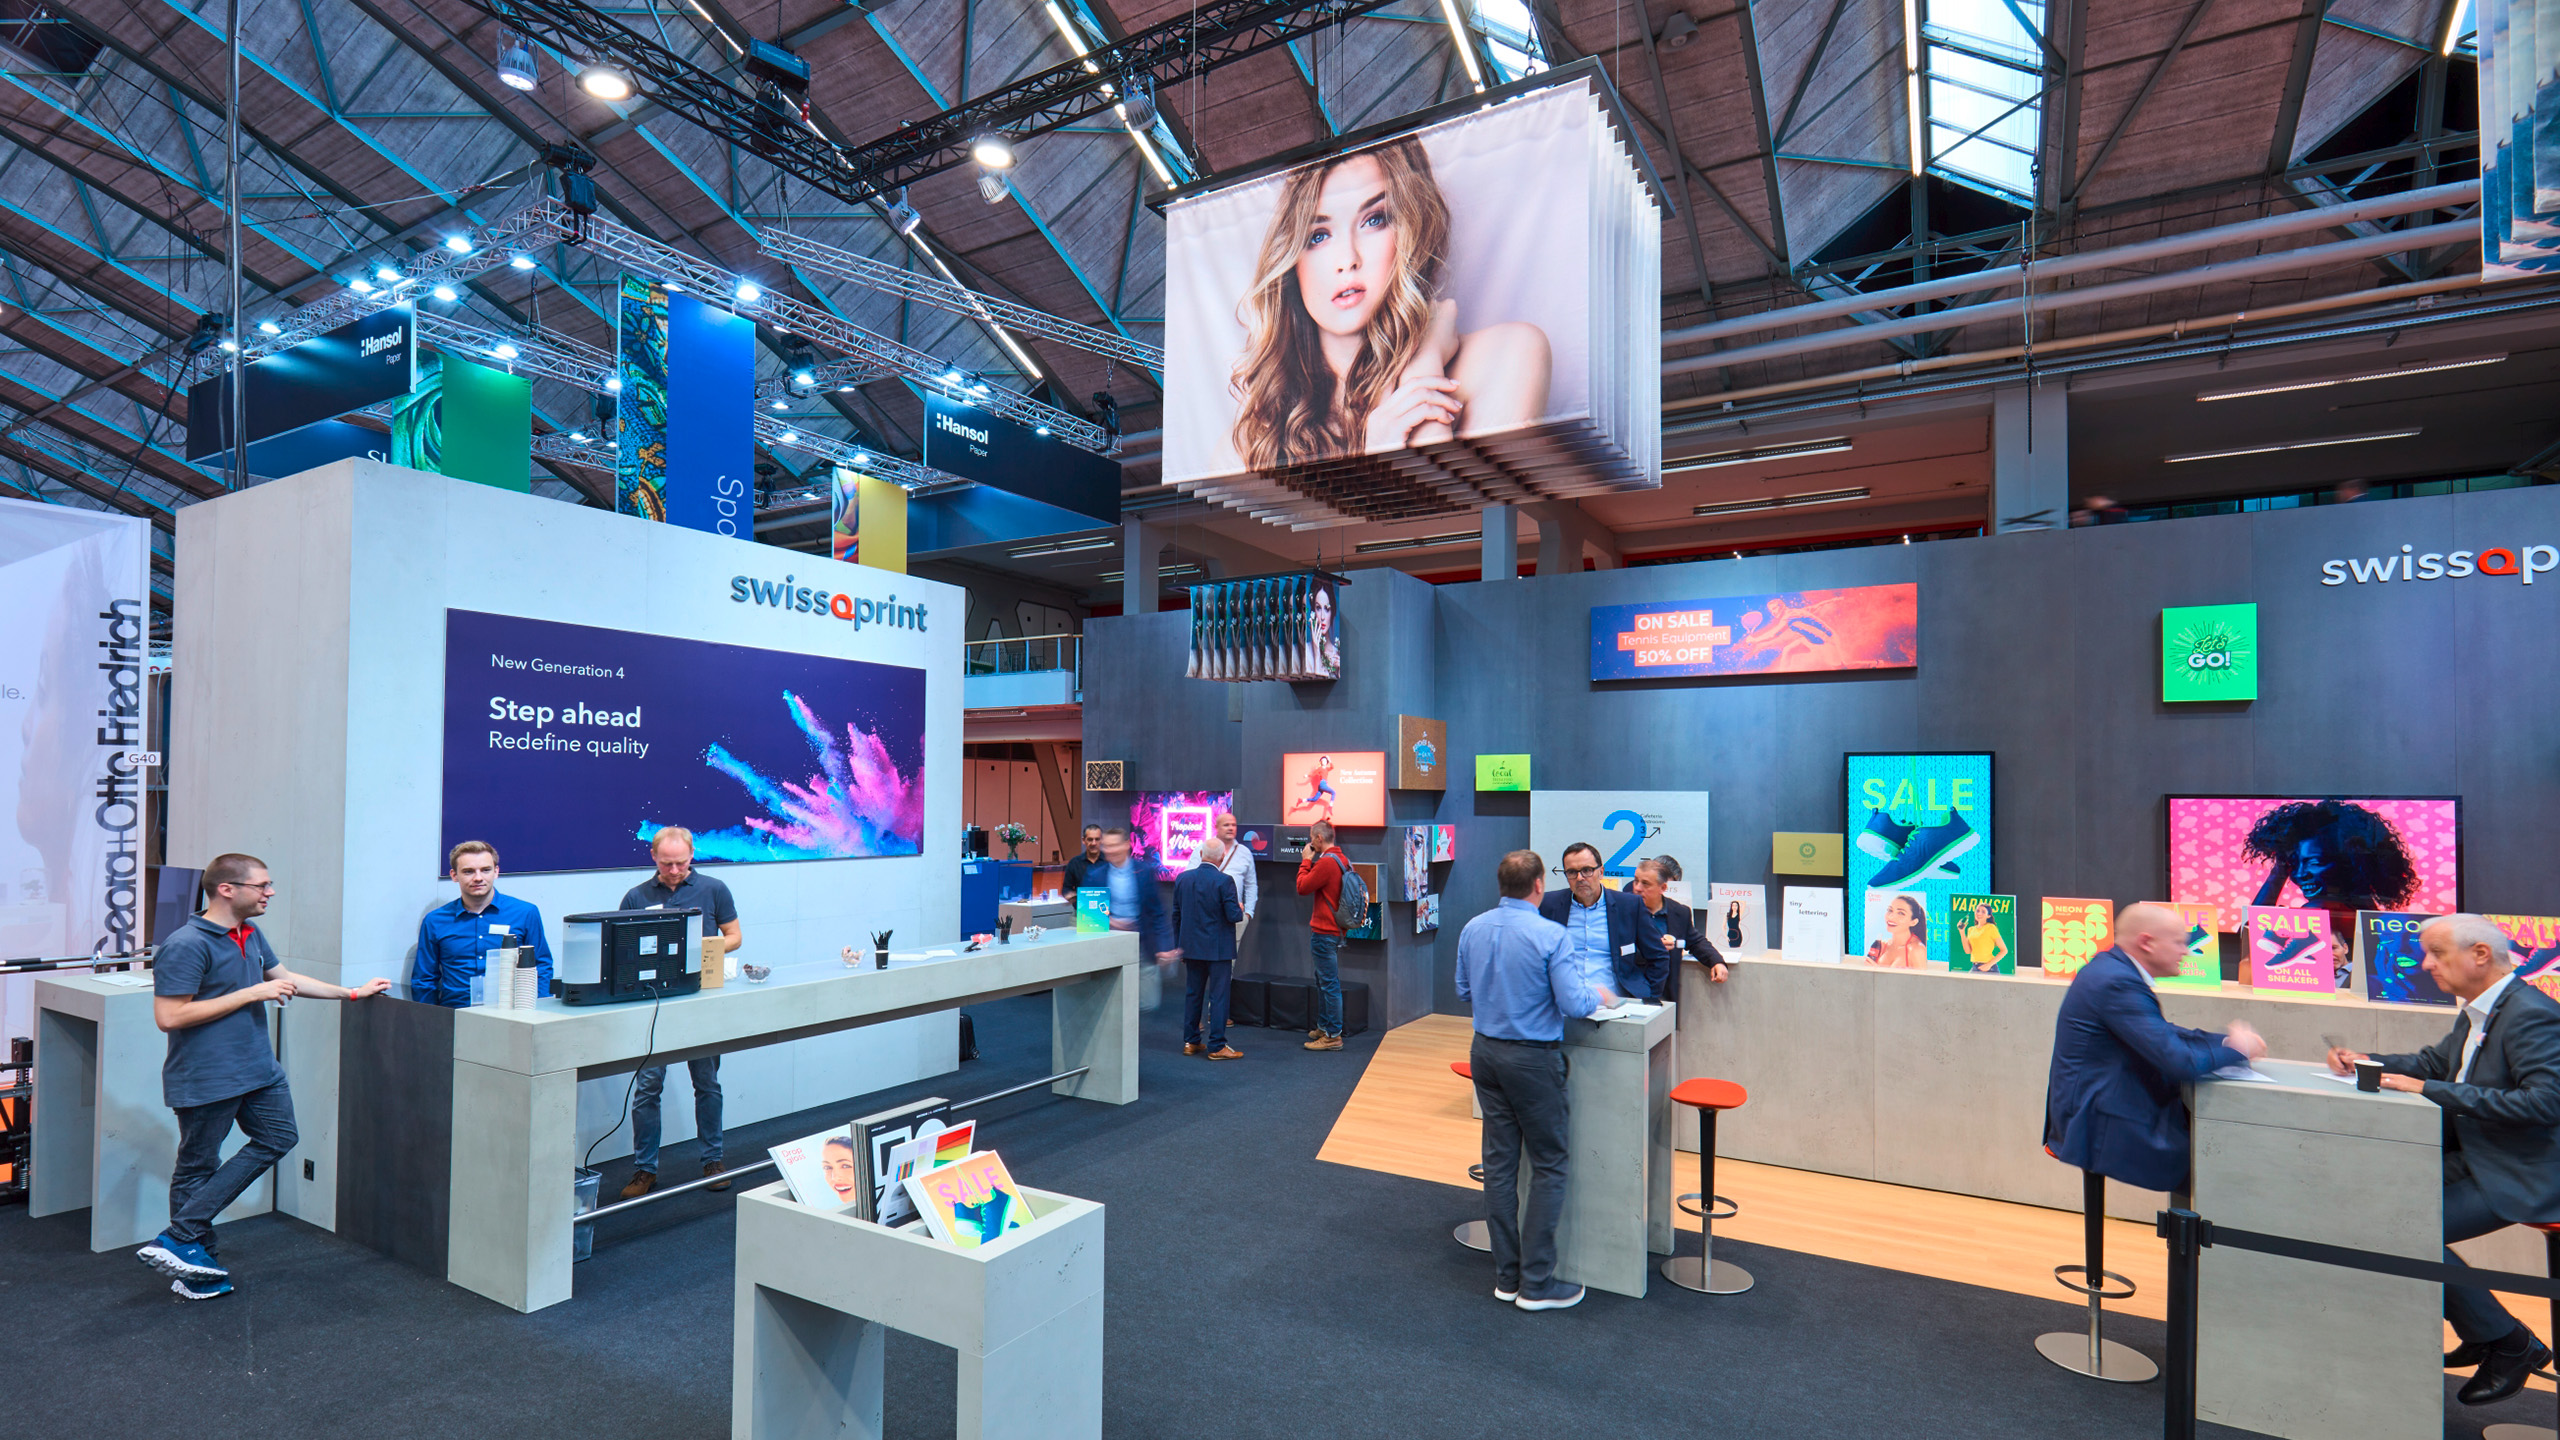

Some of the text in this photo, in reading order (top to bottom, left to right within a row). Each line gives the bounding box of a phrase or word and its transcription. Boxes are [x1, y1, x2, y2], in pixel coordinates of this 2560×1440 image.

[386, 352, 401, 365] Paper
[969, 444, 988, 457] Paper
[1638, 613, 1710, 630] ON SALE
[1622, 630, 1727, 646] Tennis Equipment
[1638, 647, 1710, 664] 50% OFF
[2188, 651, 2231, 668] GO!
[97, 598, 141, 746] Friedrich
[491, 653, 625, 679] New Generation 4
[489, 696, 641, 729] Step ahead
[489, 730, 649, 759] Redefine quality
[128, 753, 156, 764] G40
[1862, 778, 1973, 811] SALE
[1640, 826, 1646, 834] 3
[1603, 810, 1647, 877] 2
[1719, 887, 1752, 897] Layers
[1799, 909, 1828, 917] lettering
[1952, 897, 2010, 914] VARNISH
[2055, 905, 2082, 914] NEON
[2184, 910, 2208, 928] LE
[2257, 914, 2322, 934] SALE
[2369, 918, 2421, 933] neo
[2274, 967, 2311, 976] ON ALL
[2267, 975, 2319, 985] SNEAKERS
[781, 1147, 803, 1158] Drop
[786, 1153, 807, 1165] gloss
[938, 1166, 1004, 1209] SALE
